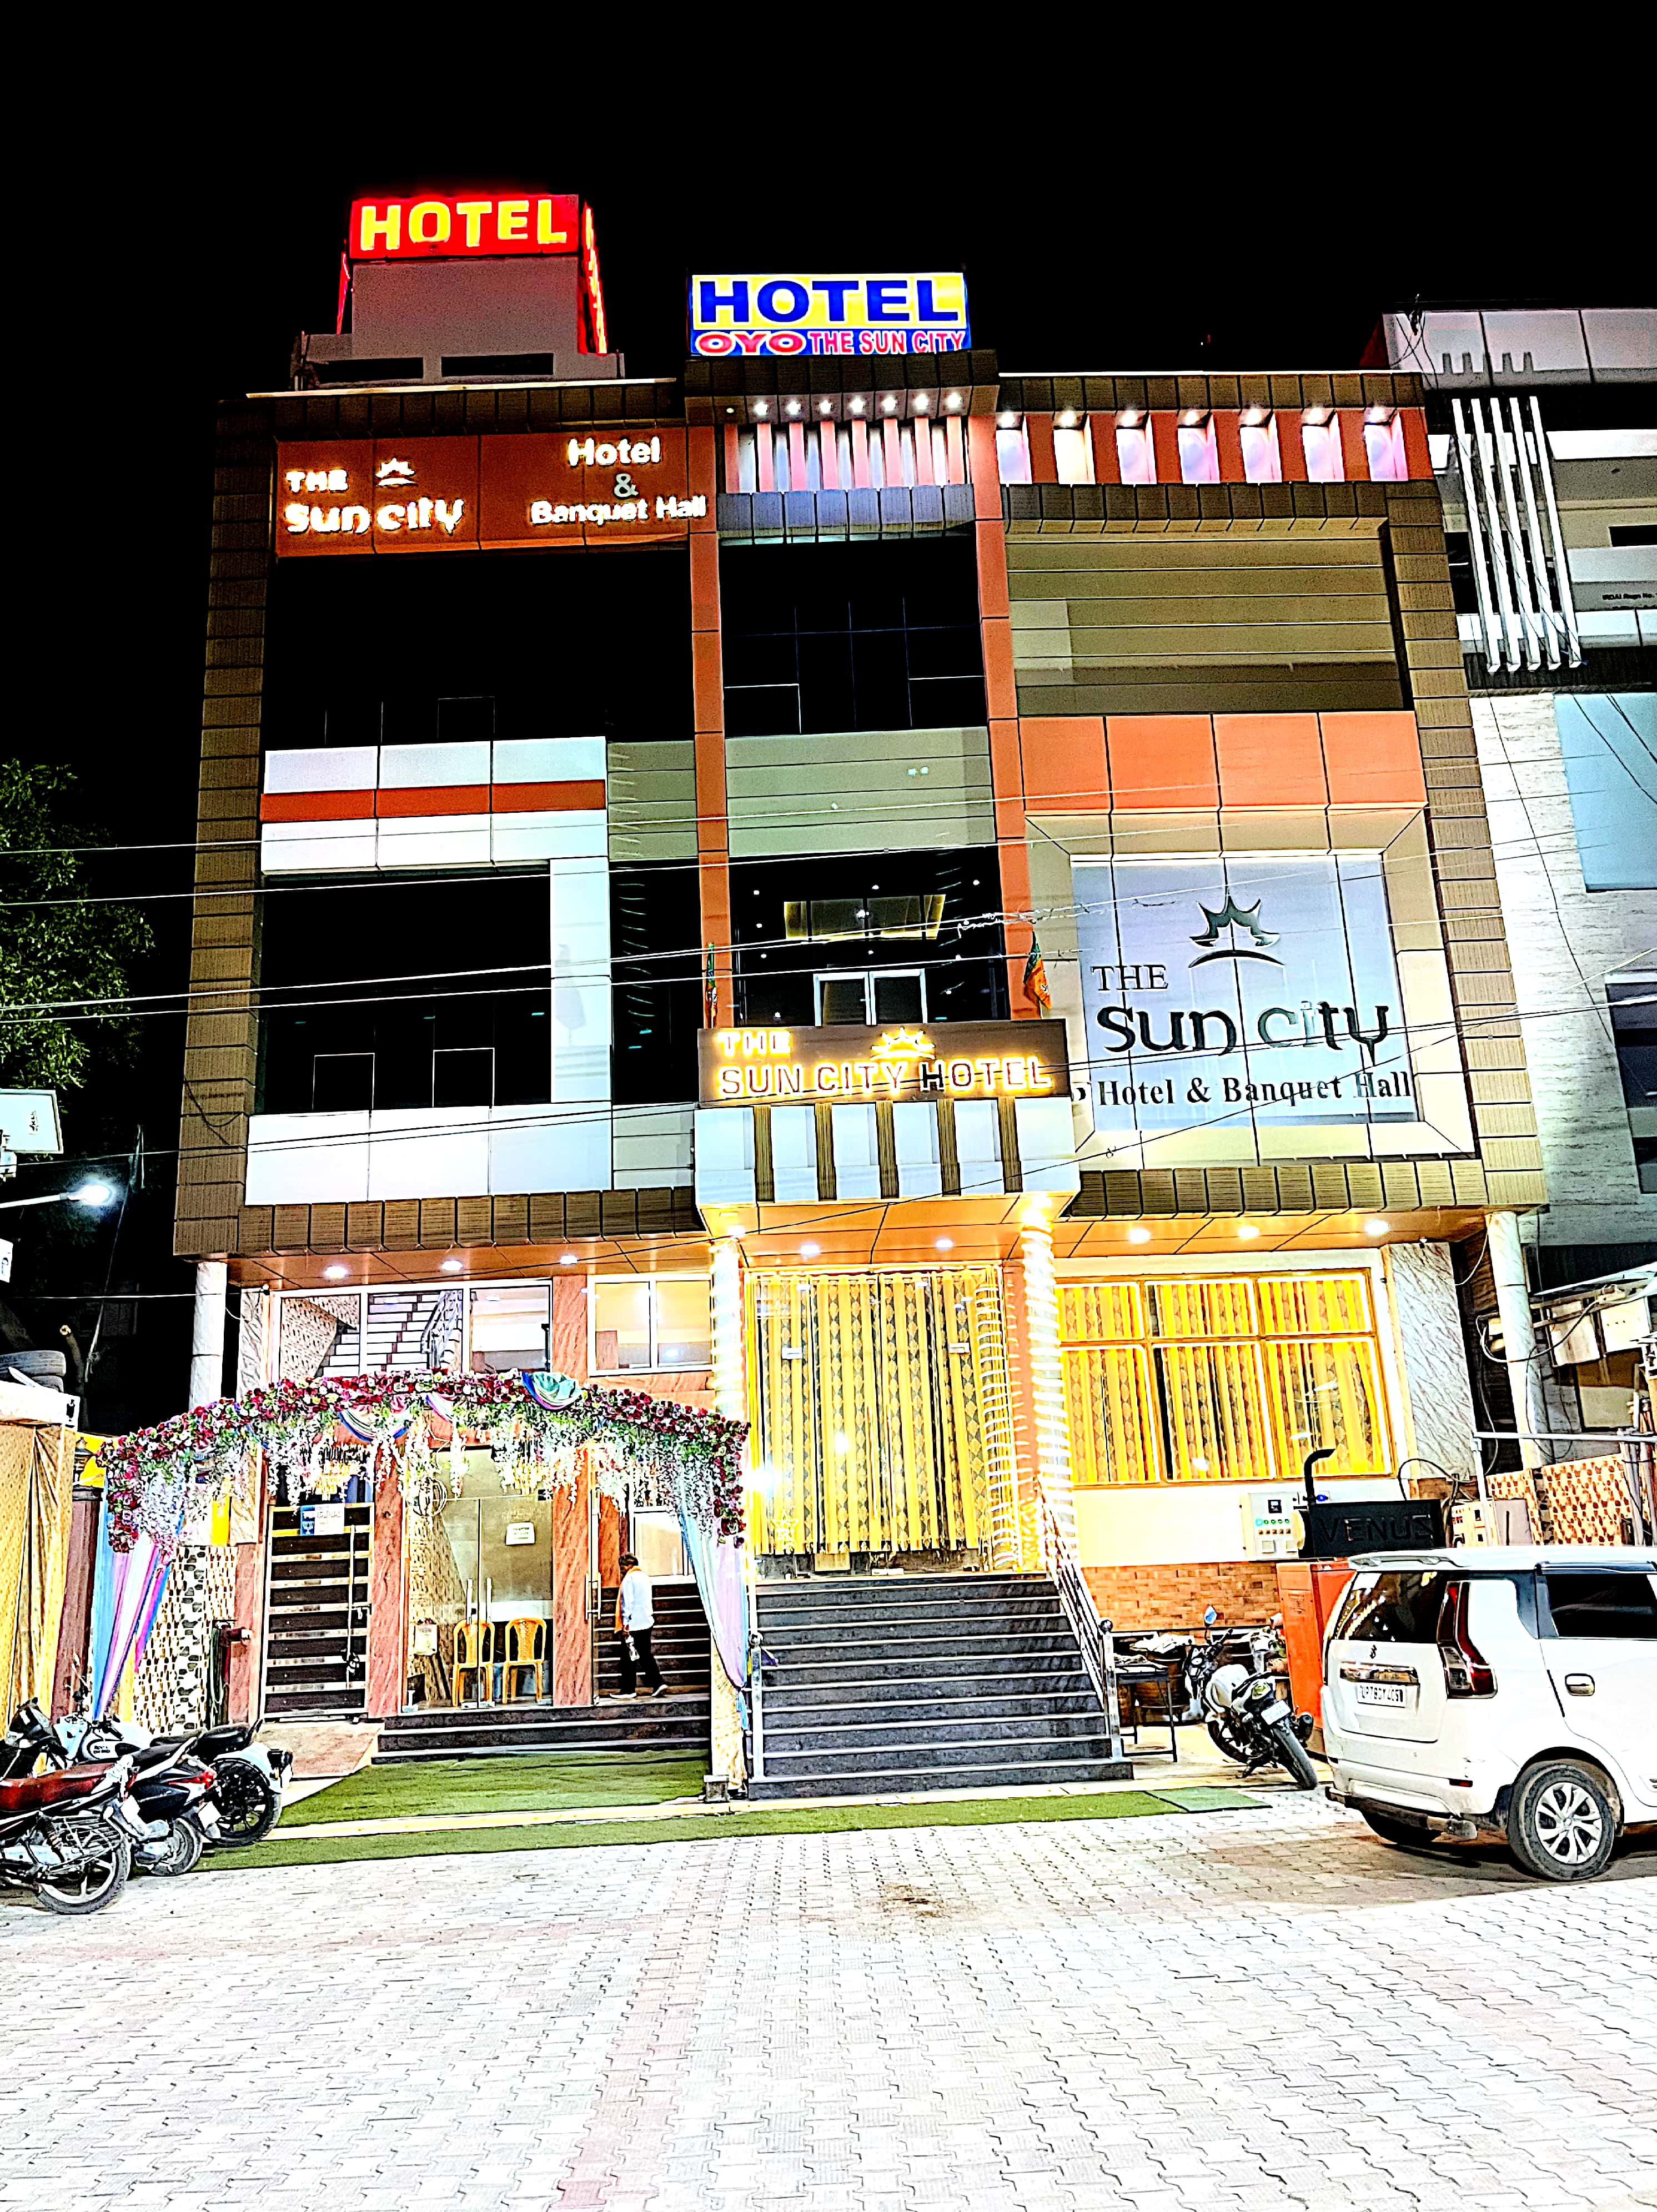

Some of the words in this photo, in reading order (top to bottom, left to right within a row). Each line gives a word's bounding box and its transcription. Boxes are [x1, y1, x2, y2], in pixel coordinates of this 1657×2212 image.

[360, 199, 567, 251] HOTEL
[700, 280, 958, 323] HOTEL
[696, 331, 805, 355] OYO
[809, 331, 854, 354] THE
[862, 331, 906, 354] SUN
[912, 330, 965, 353] CITY
[569, 436, 661, 466] Hotel
[285, 469, 349, 493] THE
[614, 473, 639, 497] &
[285, 503, 371, 534] Sun
[531, 499, 649, 527] Banquet
[656, 495, 707, 519] Hall
[1092, 964, 1169, 992] THE
[719, 1031, 791, 1055] THE
[1097, 1005, 1237, 1055] Sun
[721, 1063, 804, 1097] SUN
[815, 1061, 908, 1094] CITY
[920, 1057, 1052, 1093] HOTEL
[1098, 1079, 1174, 1105] Hotel
[1187, 1078, 1211, 1103] &
[1223, 1075, 1342, 1107] Banquet
[1355, 1071, 1412, 1099] Hall
[1319, 1514, 1434, 1542] VENUS
